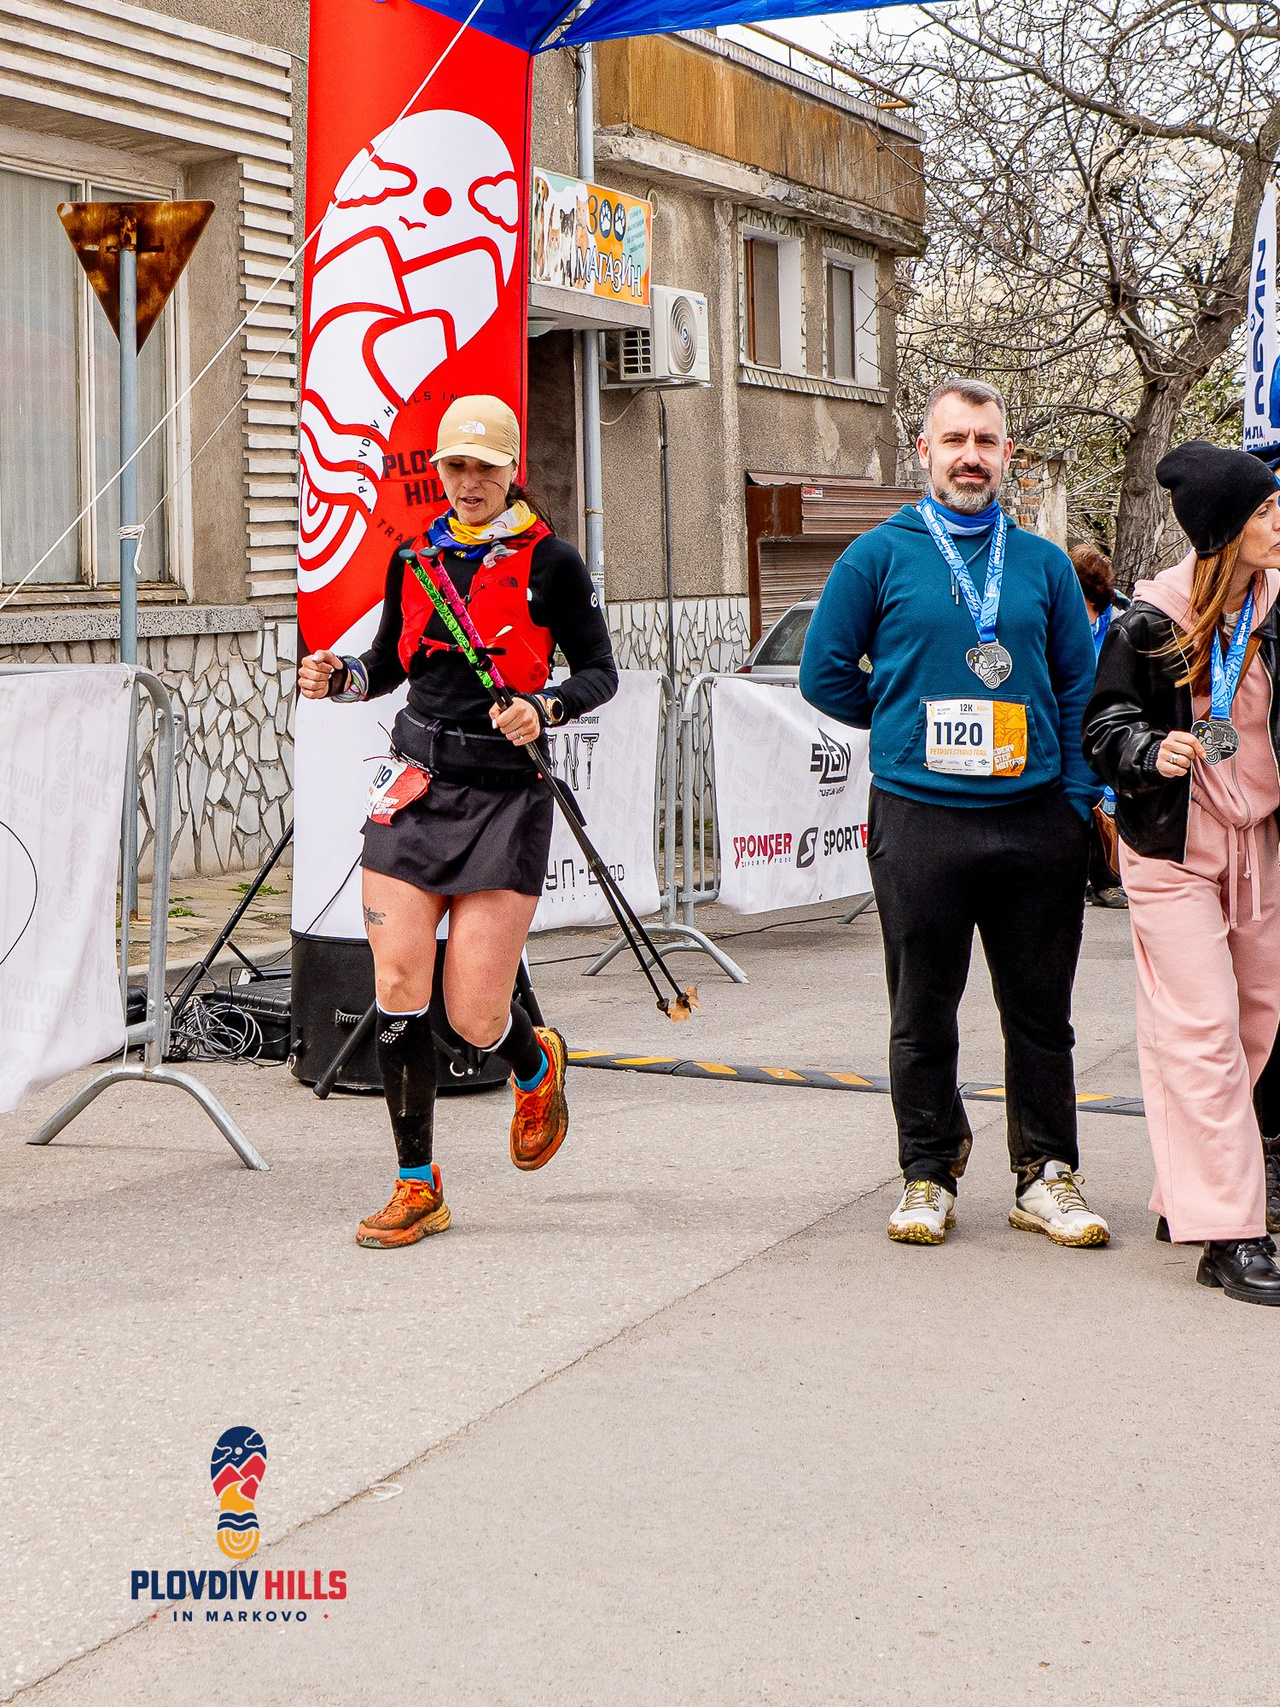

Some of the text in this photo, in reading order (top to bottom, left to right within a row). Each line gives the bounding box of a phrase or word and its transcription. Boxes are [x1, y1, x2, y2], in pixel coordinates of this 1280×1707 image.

[576, 245, 643, 297] МАГАЗИН
[356, 419, 380, 494] PLOVDIV
[383, 391, 432, 417] HILLS
[1244, 425, 1266, 440] ИЛА,
[404, 478, 445, 506] HIL
[377, 518, 404, 543] TRA
[933, 721, 983, 747] 1120
[733, 832, 793, 869] SPONSER
